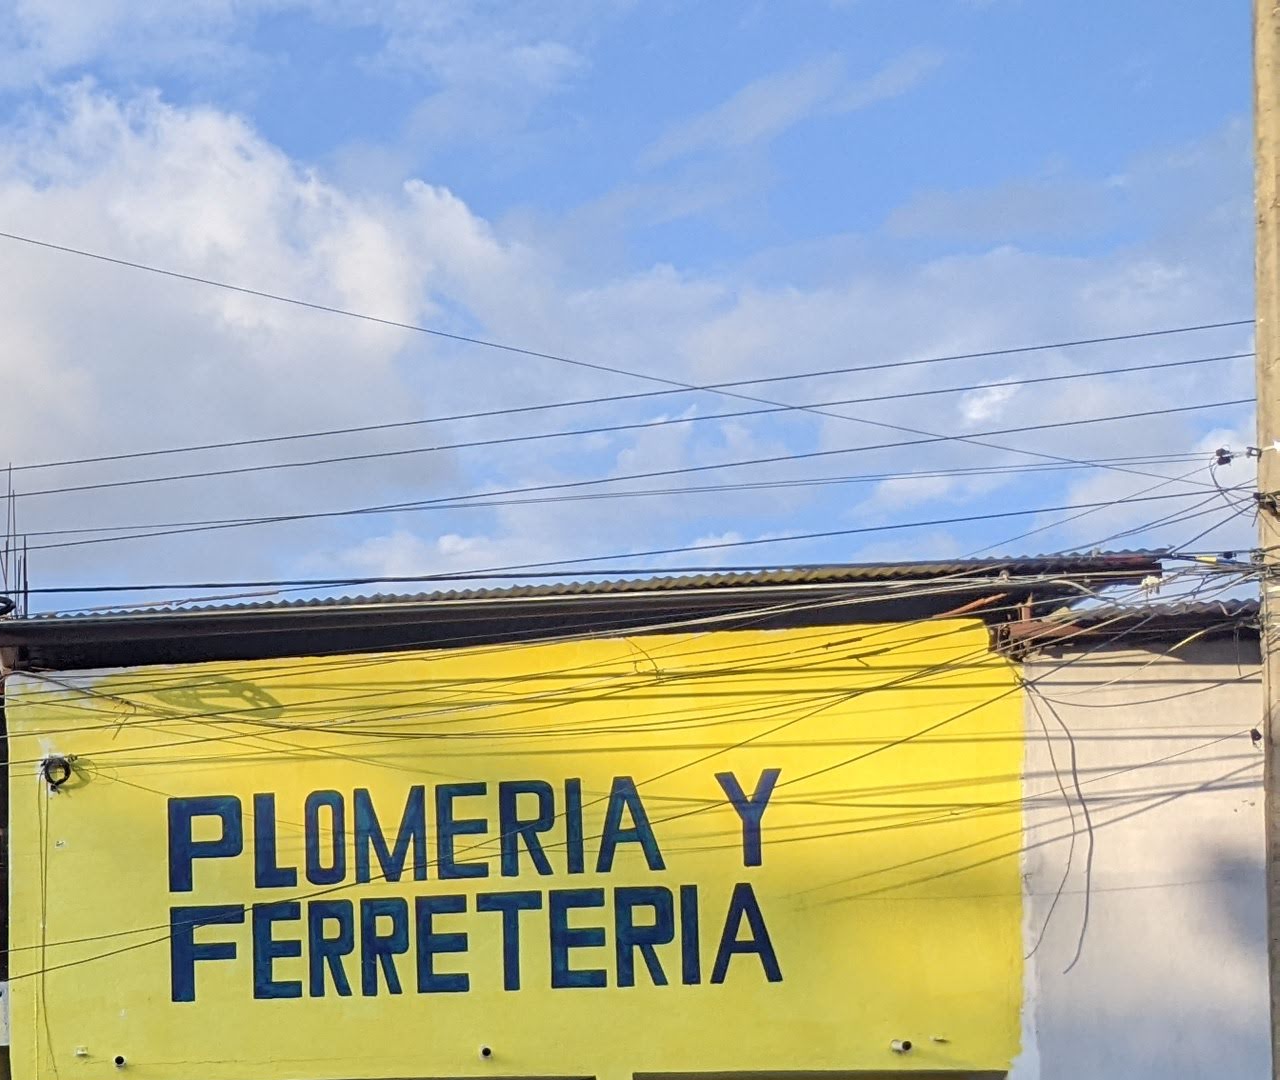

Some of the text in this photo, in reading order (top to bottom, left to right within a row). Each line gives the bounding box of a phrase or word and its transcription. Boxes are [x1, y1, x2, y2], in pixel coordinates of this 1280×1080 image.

[168, 768, 782, 892] PLOMERIA Y
[169, 883, 783, 1002] FERRETERIA
